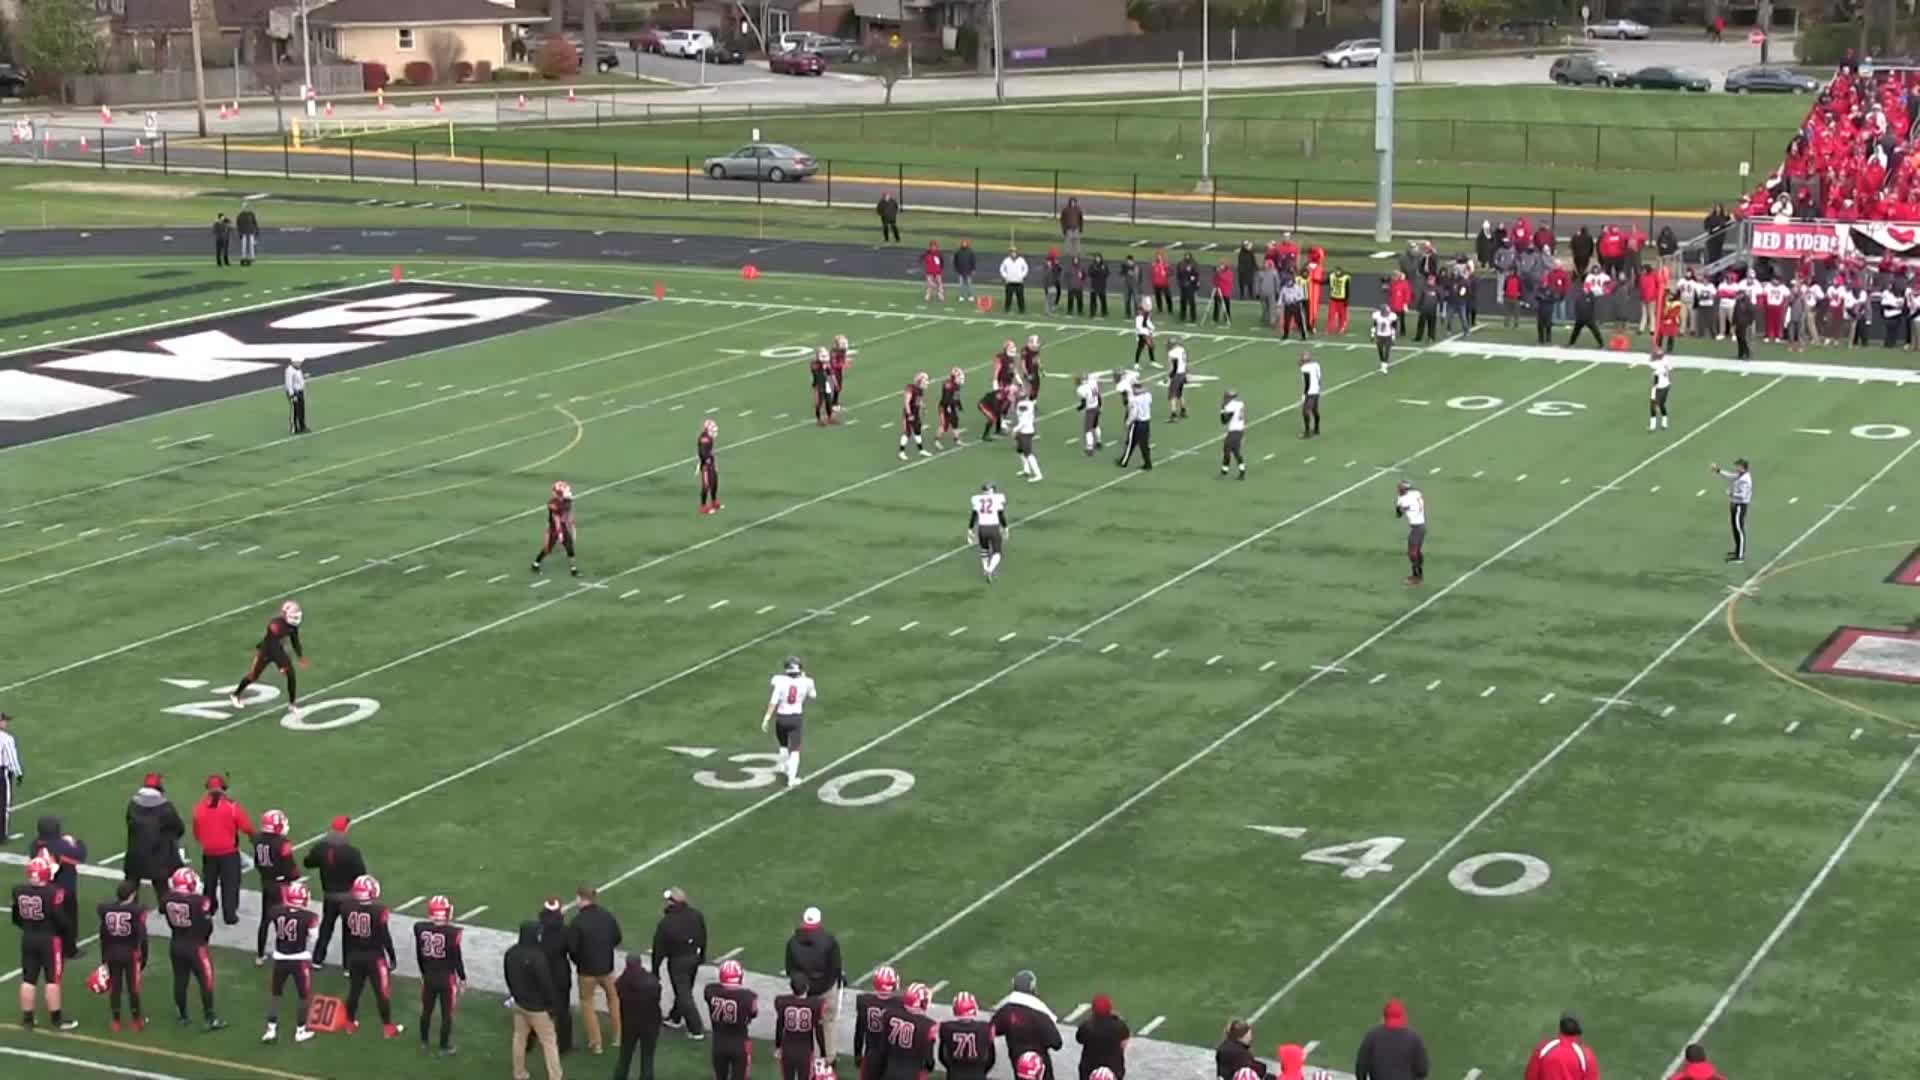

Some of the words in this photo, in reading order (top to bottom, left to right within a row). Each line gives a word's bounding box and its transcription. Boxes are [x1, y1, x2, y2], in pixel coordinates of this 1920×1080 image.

[1753, 231, 1780, 250] RED
[105, 911, 132, 936] 95
[276, 915, 298, 942] 14
[347, 911, 371, 937] 40
[421, 931, 446, 958] 32
[311, 999, 338, 1026] 30
[711, 997, 737, 1024] 79
[784, 1006, 812, 1032] 88
[867, 1007, 886, 1033] 6
[888, 1017, 915, 1048] 70
[952, 1033, 978, 1057] 71
